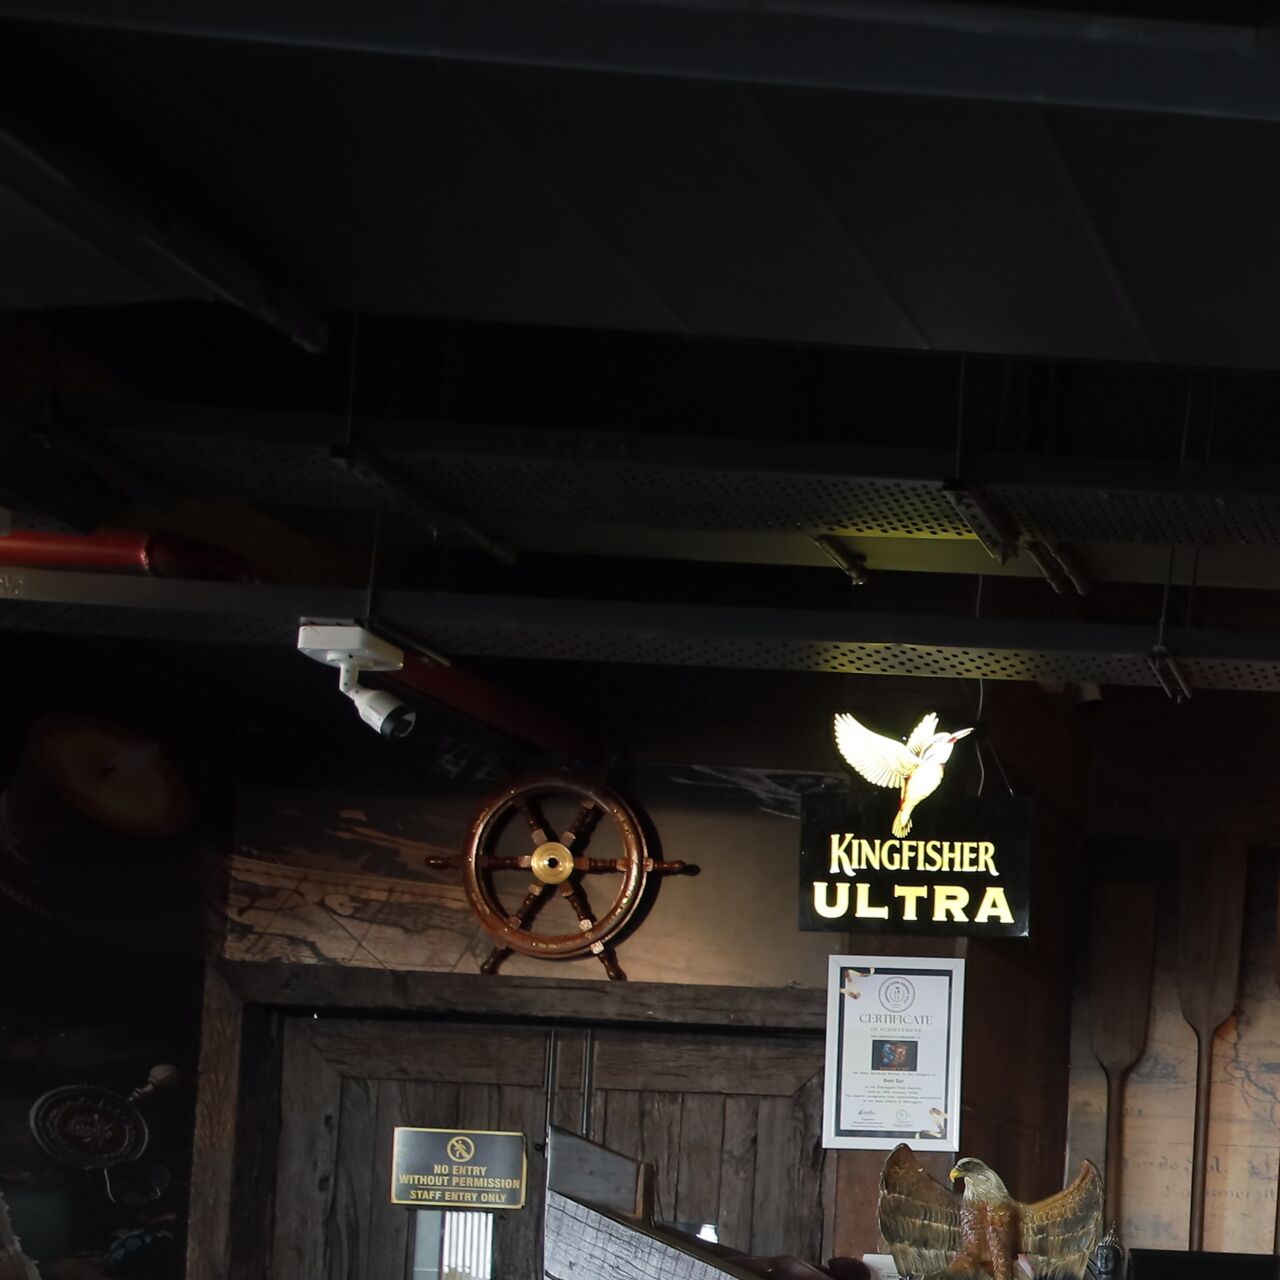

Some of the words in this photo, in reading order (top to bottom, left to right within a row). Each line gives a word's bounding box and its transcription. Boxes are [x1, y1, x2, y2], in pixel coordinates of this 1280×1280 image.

[829, 832, 1000, 877] KINGFISHER
[813, 881, 1015, 924] ULTRA
[859, 1014, 933, 1026] CERTIFICATE
[433, 1164, 449, 1174] NO
[452, 1166, 487, 1176] ENTRY
[399, 1174, 450, 1186] WITHOUT
[452, 1177, 520, 1189] PERMISSION
[410, 1190, 442, 1200] STAFF
[445, 1192, 478, 1201] ENTRY
[480, 1193, 507, 1202] ONLY
